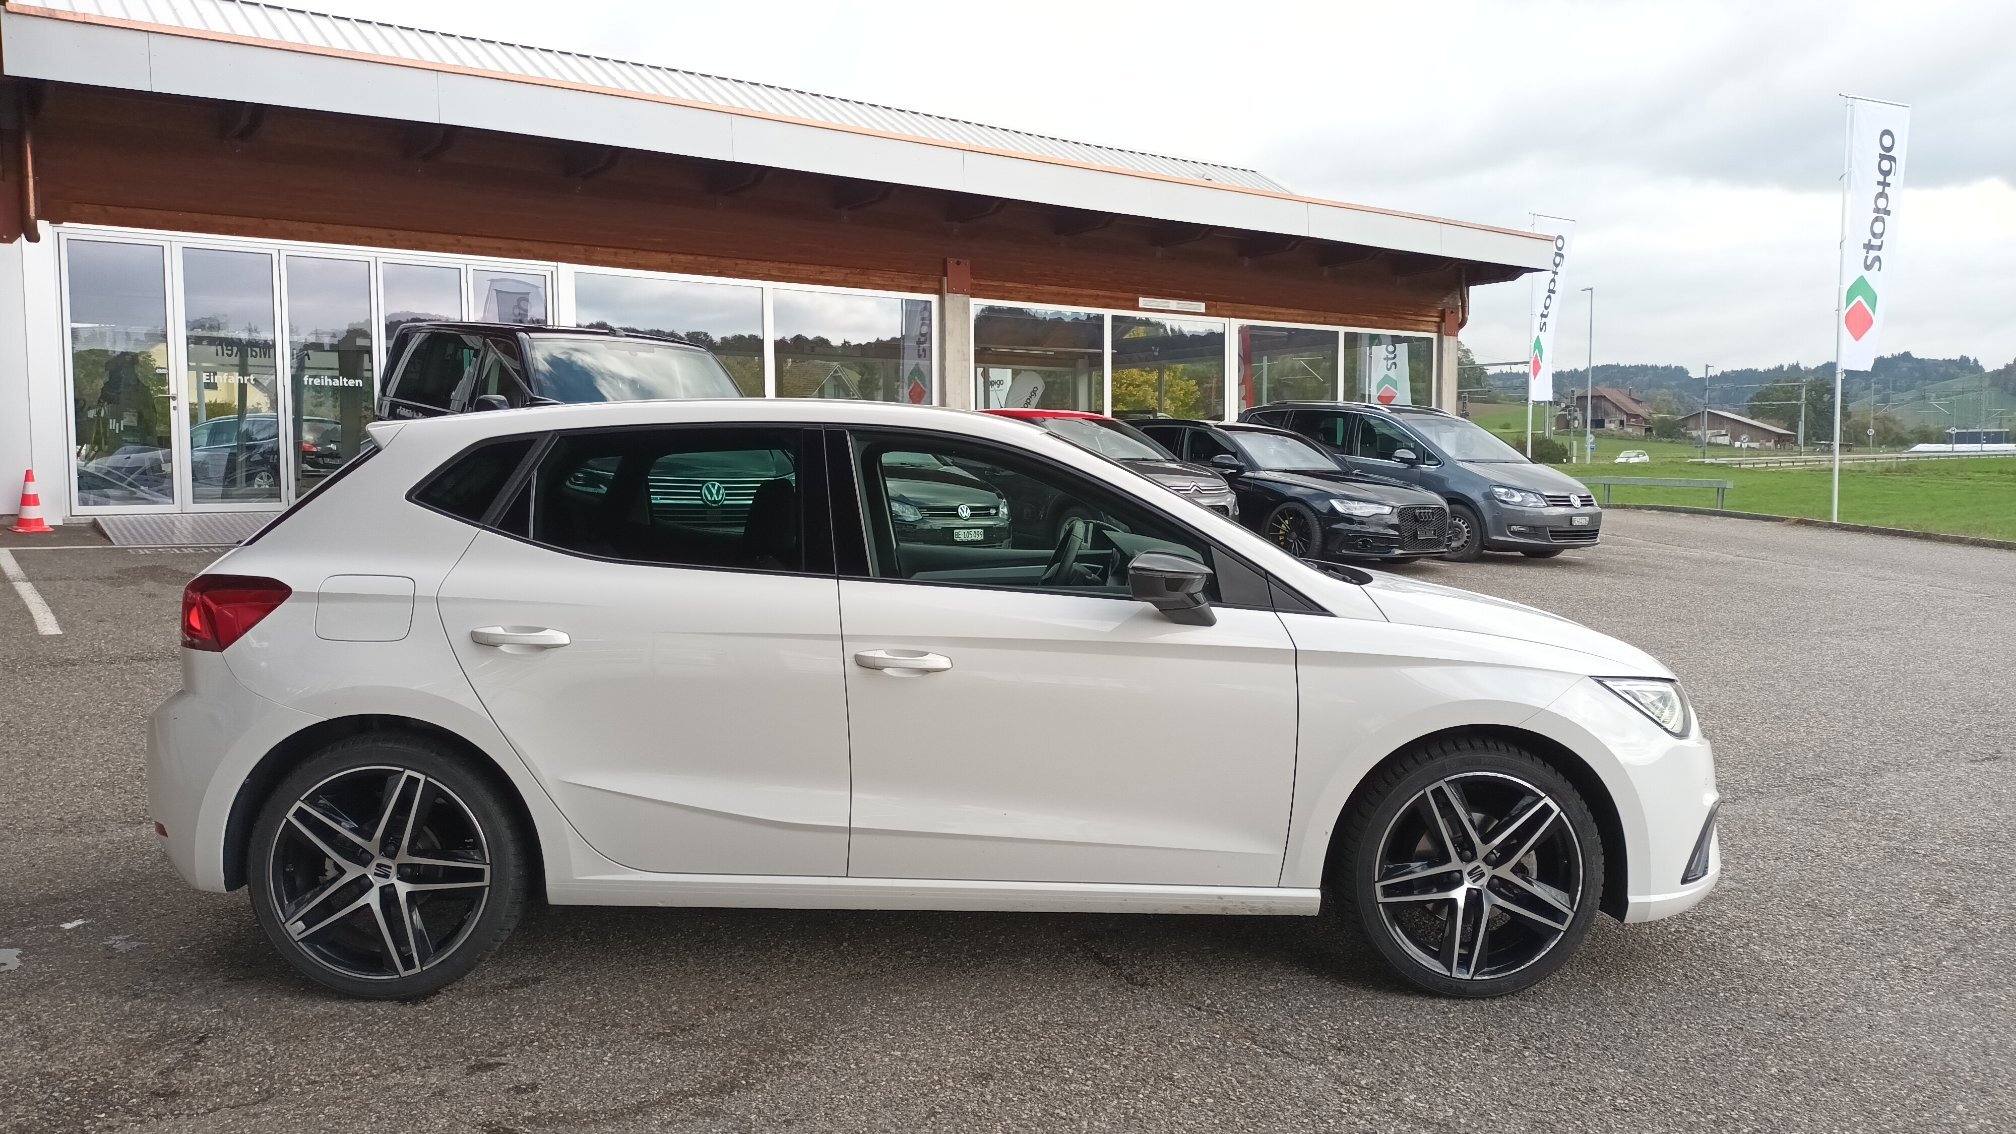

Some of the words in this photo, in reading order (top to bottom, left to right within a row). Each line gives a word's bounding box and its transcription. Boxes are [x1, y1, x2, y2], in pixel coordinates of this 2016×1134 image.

[1862, 128, 1897, 272] stop+go
[1539, 234, 1565, 333] stop+go
[202, 372, 255, 384] Einfahrt
[303, 375, 363, 387] freihalten
